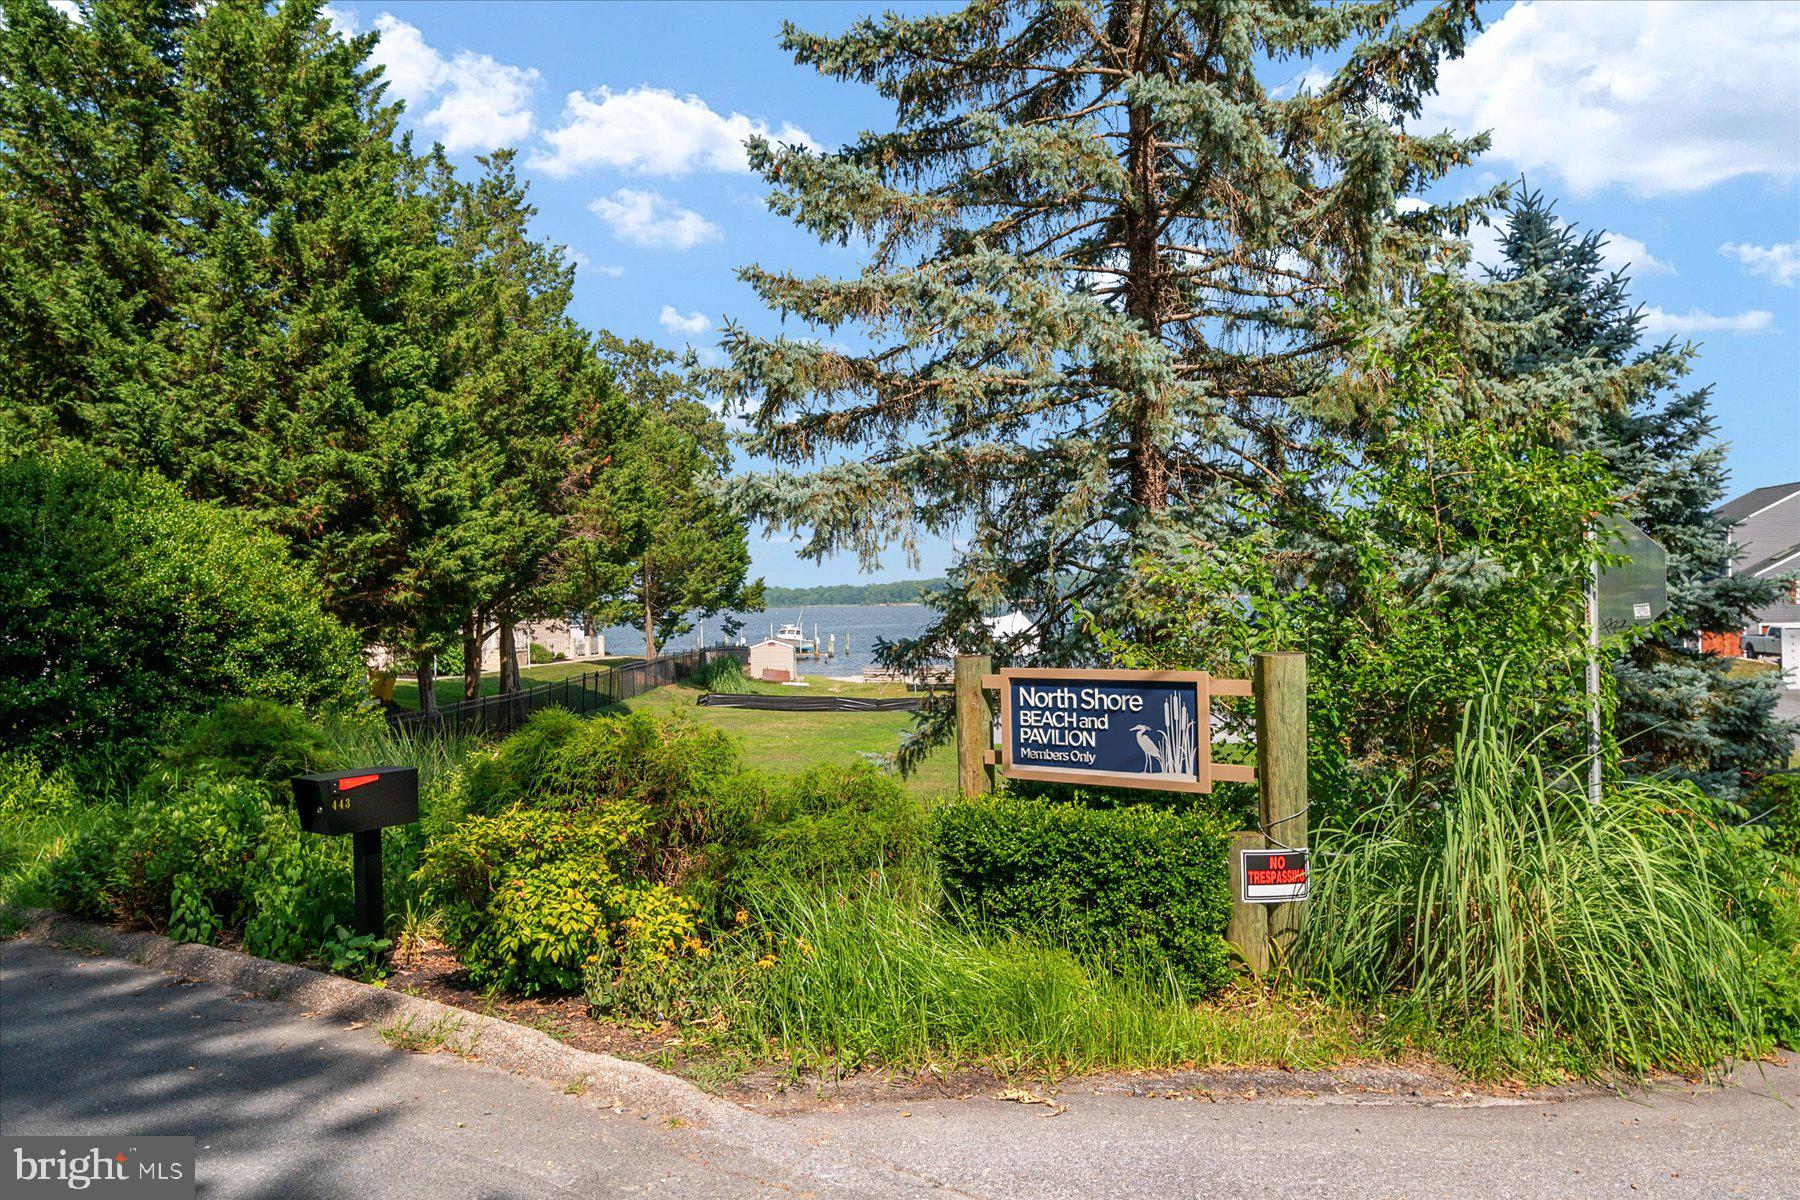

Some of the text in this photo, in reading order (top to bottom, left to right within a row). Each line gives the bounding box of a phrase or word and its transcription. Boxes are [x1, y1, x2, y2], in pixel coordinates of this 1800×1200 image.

[1019, 687, 1143, 712] North Shore
[1020, 710, 1109, 730] BEACH and
[1020, 727, 1096, 748] PAVILION
[1020, 747, 1096, 765] Members Only
[331, 798, 351, 810] 443
[1269, 855, 1286, 870] NO
